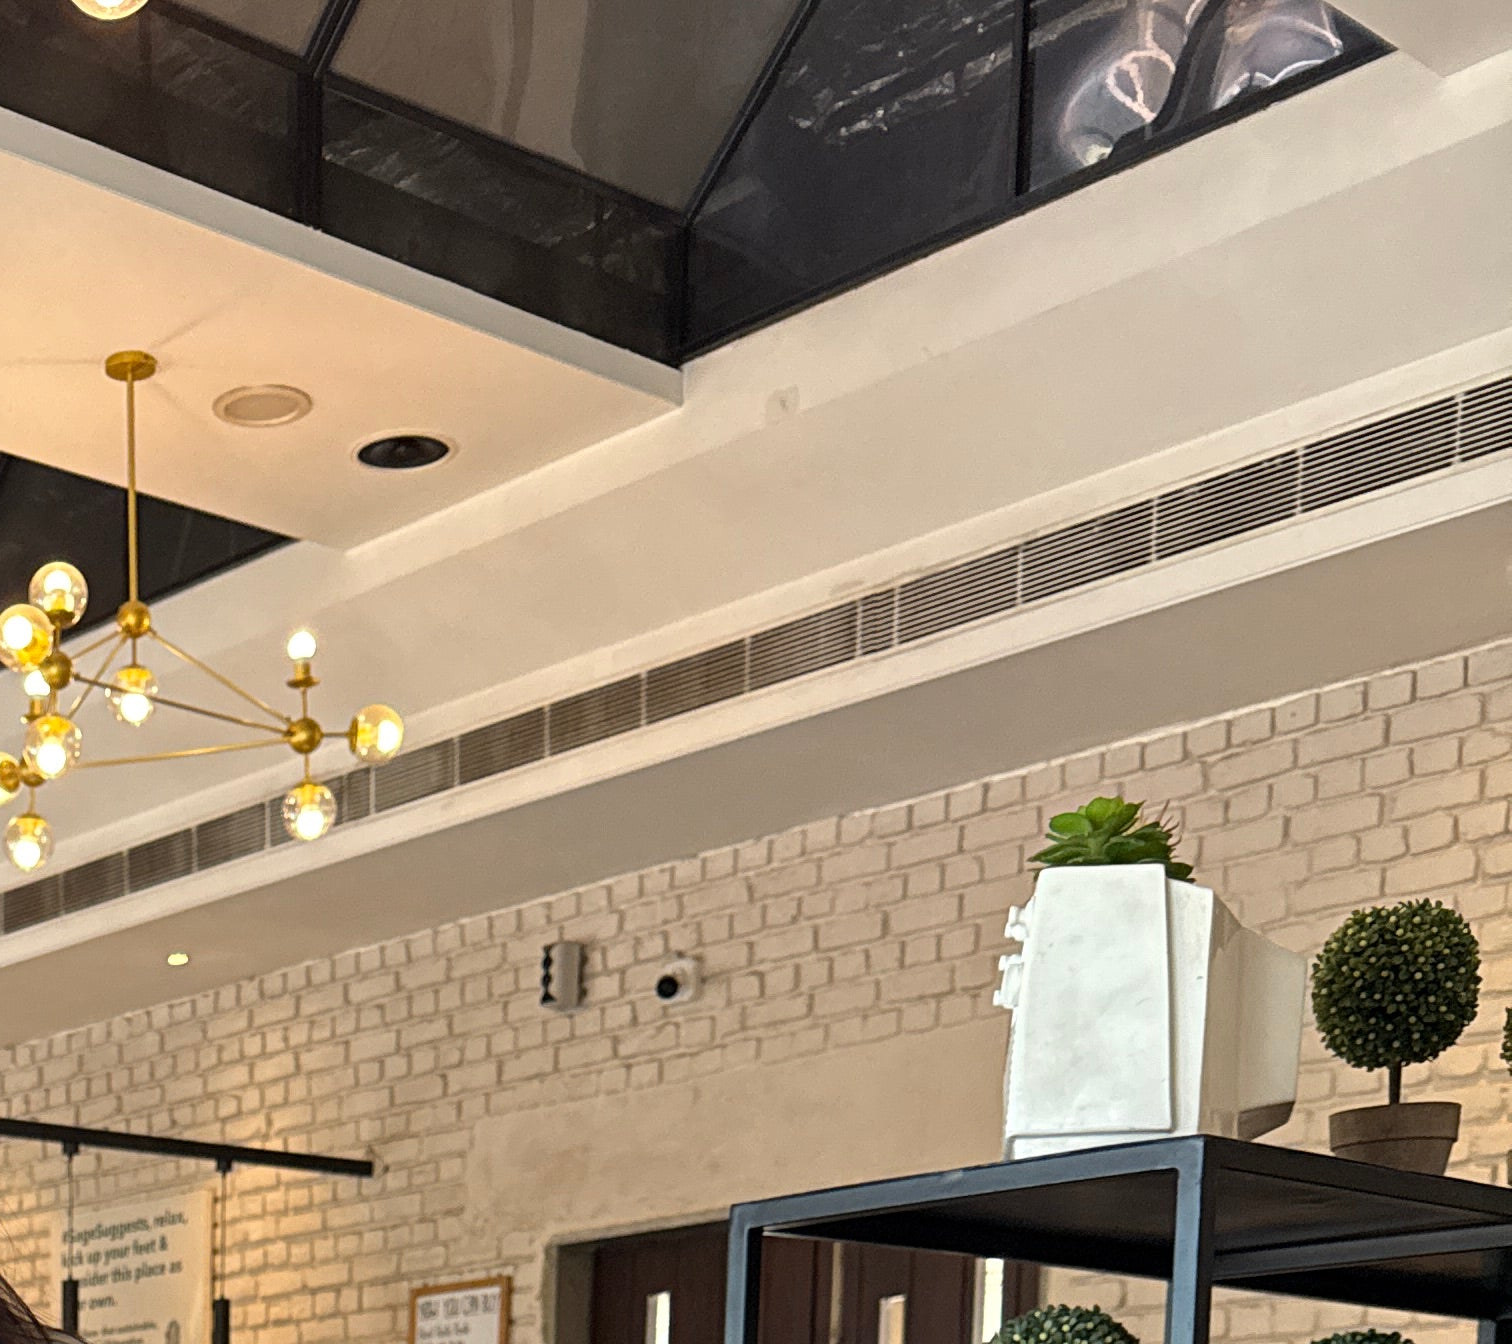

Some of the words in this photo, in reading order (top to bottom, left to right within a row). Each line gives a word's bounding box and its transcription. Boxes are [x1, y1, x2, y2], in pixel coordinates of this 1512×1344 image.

[87, 1251, 102, 1268] up
[104, 1247, 130, 1266] your
[132, 1239, 157, 1255] feet
[111, 1265, 132, 1283] this
[134, 1262, 166, 1284] place
[169, 1261, 182, 1273] as
